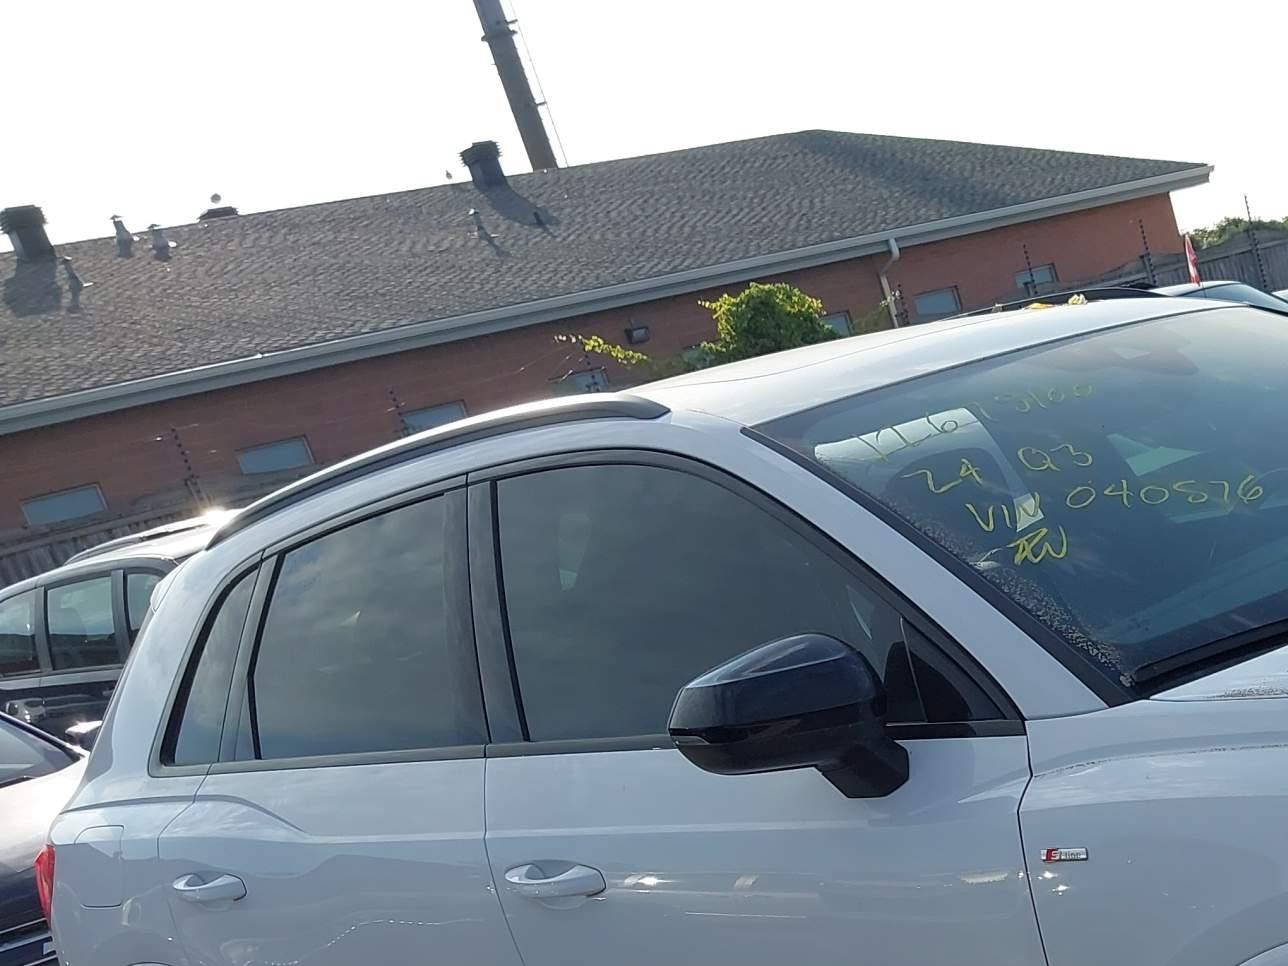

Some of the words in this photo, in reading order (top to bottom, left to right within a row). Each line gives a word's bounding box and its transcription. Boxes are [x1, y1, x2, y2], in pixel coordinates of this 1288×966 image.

[902, 456, 983, 495] 24
[1017, 443, 1093, 471] Q3
[965, 491, 1041, 532] VIN
